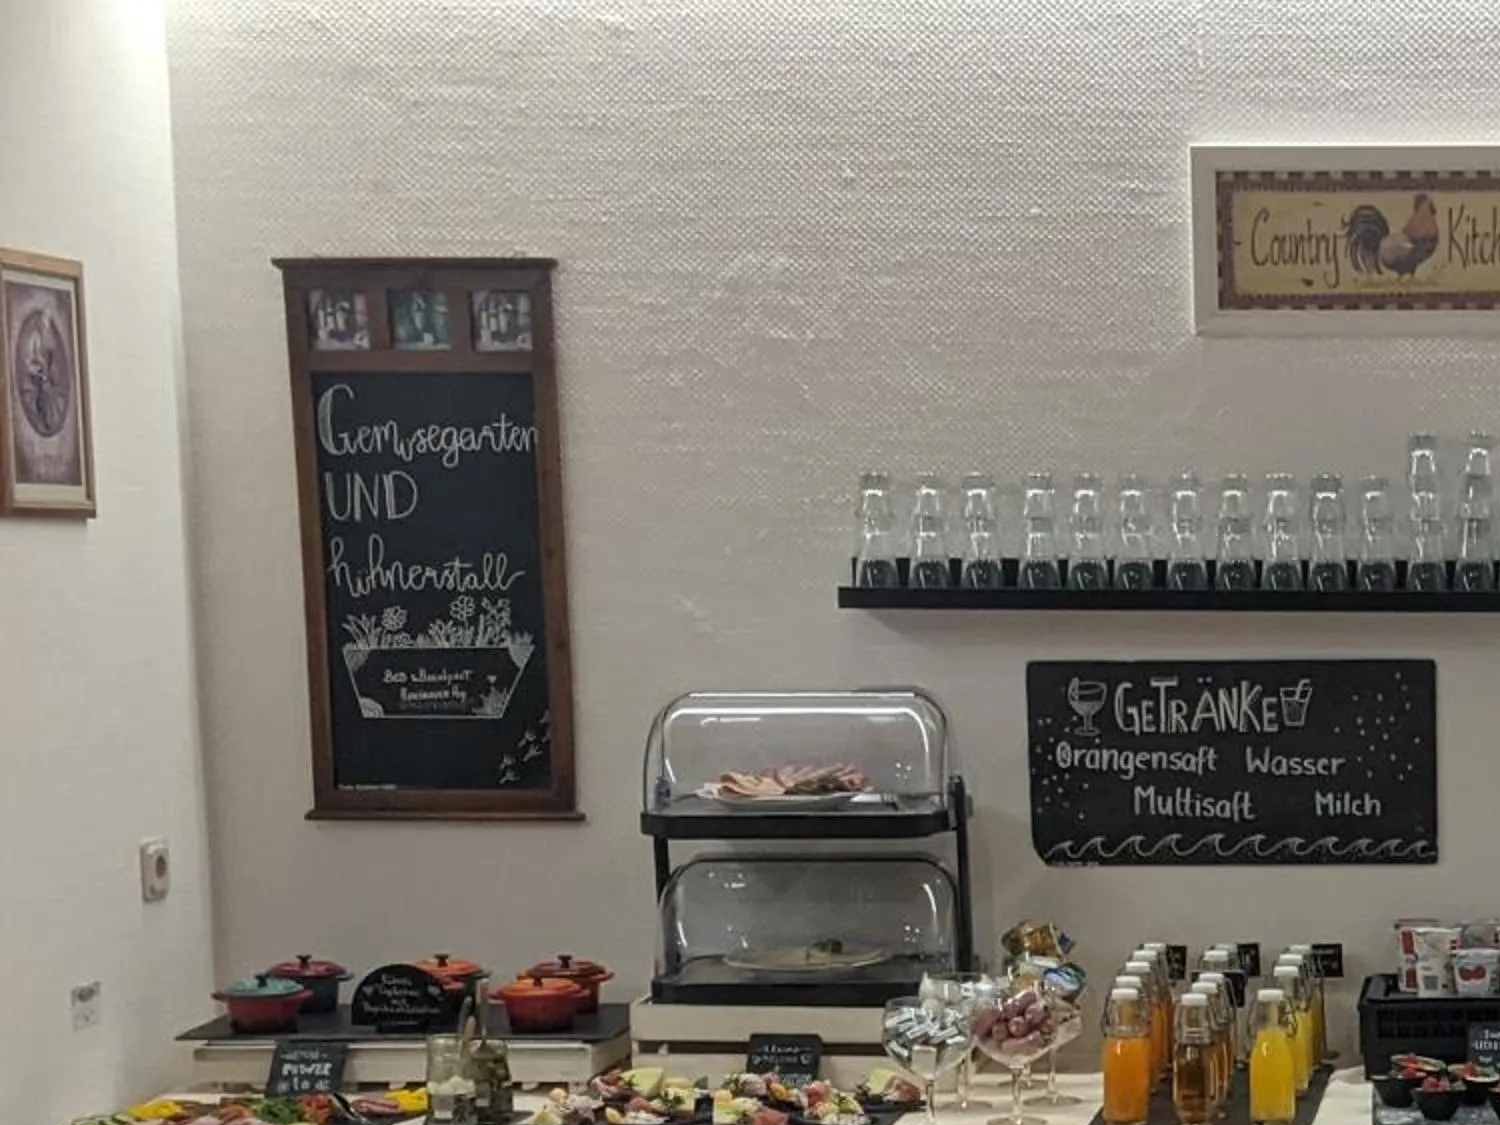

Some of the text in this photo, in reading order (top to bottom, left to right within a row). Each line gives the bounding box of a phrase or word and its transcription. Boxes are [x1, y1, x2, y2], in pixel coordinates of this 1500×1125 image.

[1250, 206, 1343, 288] Country
[325, 470, 418, 522] UND
[1055, 741, 1348, 781] Orangensaft Wasser
[1133, 785, 1382, 823] Multisaft Milch
